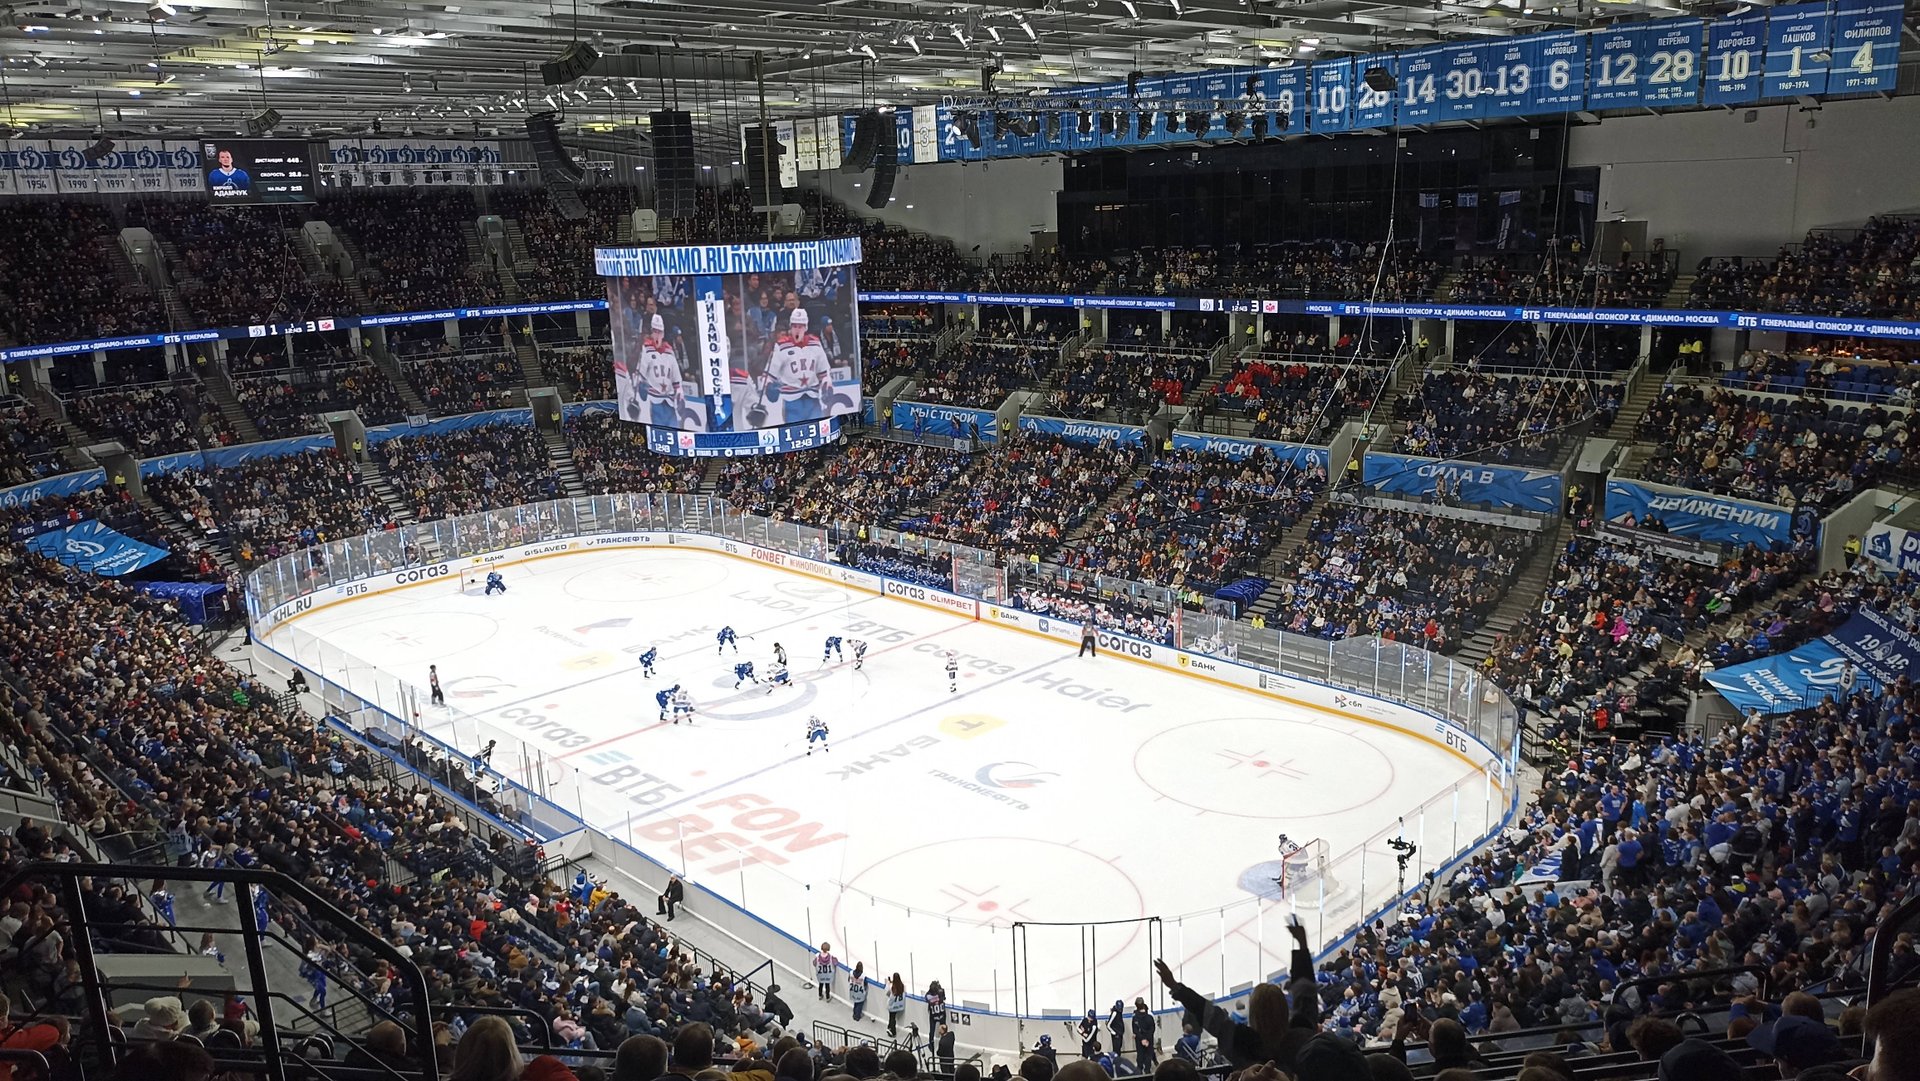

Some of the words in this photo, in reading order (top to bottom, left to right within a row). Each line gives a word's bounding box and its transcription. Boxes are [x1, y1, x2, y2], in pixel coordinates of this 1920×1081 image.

[1782, 31, 1816, 44] ПАШКОВ
[1844, 26, 1891, 39] ФИЛИППОВ
[1658, 36, 1690, 46] ПЕТРЕНКО
[1717, 36, 1756, 50] ДОРОФЕЕВ
[1788, 46, 1802, 78] 1
[1851, 41, 1873, 74] 4
[1598, 53, 1638, 87] 12
[1648, 49, 1694, 84] 28
[1718, 50, 1750, 81] 10
[1494, 64, 1530, 96] 13
[1550, 58, 1570, 90] 6
[1404, 74, 1437, 106] 14
[1446, 68, 1482, 100] 30
[1317, 84, 1346, 114] 10
[920, 126, 930, 148] 3
[27, 178, 47, 189] 1954
[68, 179, 88, 189] 1990
[106, 179, 125, 188] 1991
[143, 178, 161, 187] 1992
[179, 178, 196, 187] 1993
[641, 246, 728, 274] DYNAMO.RU
[1218, 300, 1224, 310] 1
[1251, 301, 1259, 311] 3
[1345, 306, 1360, 314] ВТБ
[466, 309, 480, 317] ВТБ
[1522, 310, 1540, 319] ВТБ
[1544, 311, 1594, 320] ГЕНЕРАЛЬНЫЙ
[1595, 312, 1629, 321] СПОНСОР
[1641, 314, 1684, 323] «ДИНАМО»
[1685, 315, 1719, 324] МОСКВА
[271, 324, 278, 335] 1
[306, 321, 316, 332] 3
[1738, 316, 1757, 327] ВТБ
[1761, 318, 1814, 329] ГЕНЕРАЛЬНЫЙ
[1815, 321, 1852, 331] СПОНСОР
[1853, 324, 1865, 332] ХК
[1866, 324, 1913, 336] «ДИНАМО»
[54, 344, 81, 354] СПОНСОР
[124, 338, 150, 346] МОСКВА
[164, 335, 180, 344] ВТБ
[790, 360, 816, 374] СКА
[931, 410, 937, 419] С
[652, 430, 656, 442] 1
[785, 429, 793, 441] 1
[808, 424, 817, 437] 3
[1062, 425, 1120, 440] ДИНАМО
[666, 432, 674, 444] 3
[791, 439, 812, 449] 12:43
[1417, 465, 1474, 482] СИЛА
[1479, 471, 1494, 484] В
[1648, 495, 1780, 530] ДВИЖЕНИИ
[47, 519, 60, 528] ВТБ
[23, 526, 34, 536] ВТБ
[596, 536, 650, 544] ТРАНСНЕФТЬ
[524, 544, 568, 556] GISLAVED
[725, 542, 738, 554] ВТБ
[484, 554, 505, 562] БАНК
[751, 548, 787, 566] FONBET
[346, 583, 368, 596] ВТБ
[273, 597, 312, 624] KHL.RU
[1001, 612, 1019, 621] БАНК
[841, 620, 915, 643] ВТБ
[1855, 634, 1880, 650] 19
[1191, 660, 1216, 672] БАНК
[1754, 668, 1804, 702] ДИНАМО
[1022, 672, 1152, 713] Haier
[1446, 731, 1467, 753] ВТБ
[590, 764, 684, 806] ВТБ
[928, 768, 1030, 811] ТРАНСНЕФТЬ
[696, 793, 850, 852] FON
[632, 814, 790, 875] BET
[818, 965, 832, 974] 201
[850, 982, 864, 994] 204
